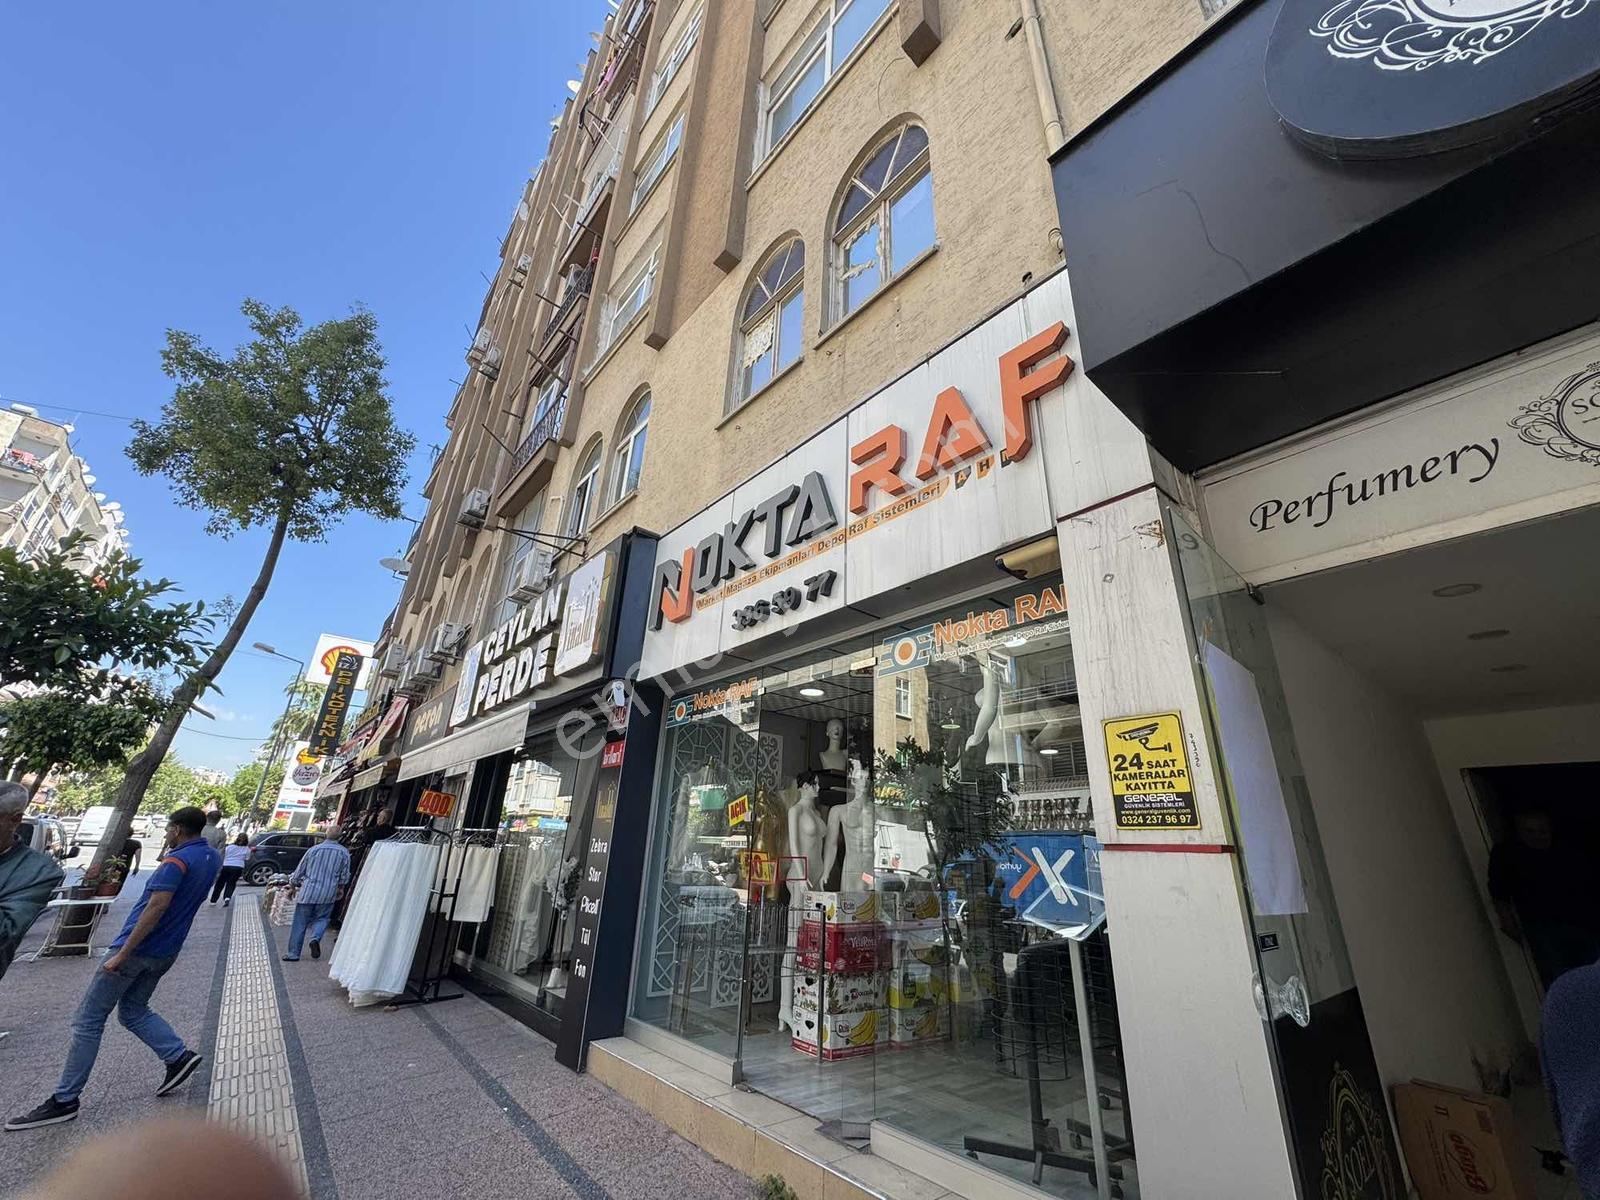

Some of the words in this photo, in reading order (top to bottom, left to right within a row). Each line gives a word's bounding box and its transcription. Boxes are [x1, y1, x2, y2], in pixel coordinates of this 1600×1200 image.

[648, 470, 838, 631] NOKTA
[850, 321, 1075, 516] RAF
[1249, 438, 1500, 533] Perfumery
[818, 533, 845, 552] Depo
[849, 517, 870, 536] Raf
[872, 483, 941, 524] Sistemleri
[804, 569, 837, 602] 77
[484, 583, 563, 665] CEYLAN
[934, 608, 1008, 647] Nokta
[472, 632, 554, 717] PERDE
[694, 688, 726, 711] Nokta
[729, 677, 758, 699] RAF
[1113, 753, 1144, 771] 24
[1147, 759, 1177, 769] SAAT
[1113, 769, 1186, 782] KAMERALAR
[1125, 781, 1175, 791] KAYITTA
[420, 792, 451, 815] 400
[1122, 815, 1143, 824] 0324
[1146, 815, 1162, 824] 237
[1165, 815, 1178, 823] 96
[1180, 814, 1192, 823] 97
[590, 838, 608, 854] Zebra
[588, 866, 602, 882] Stor
[580, 926, 591, 946] Tül
[574, 958, 586, 979] Fon
